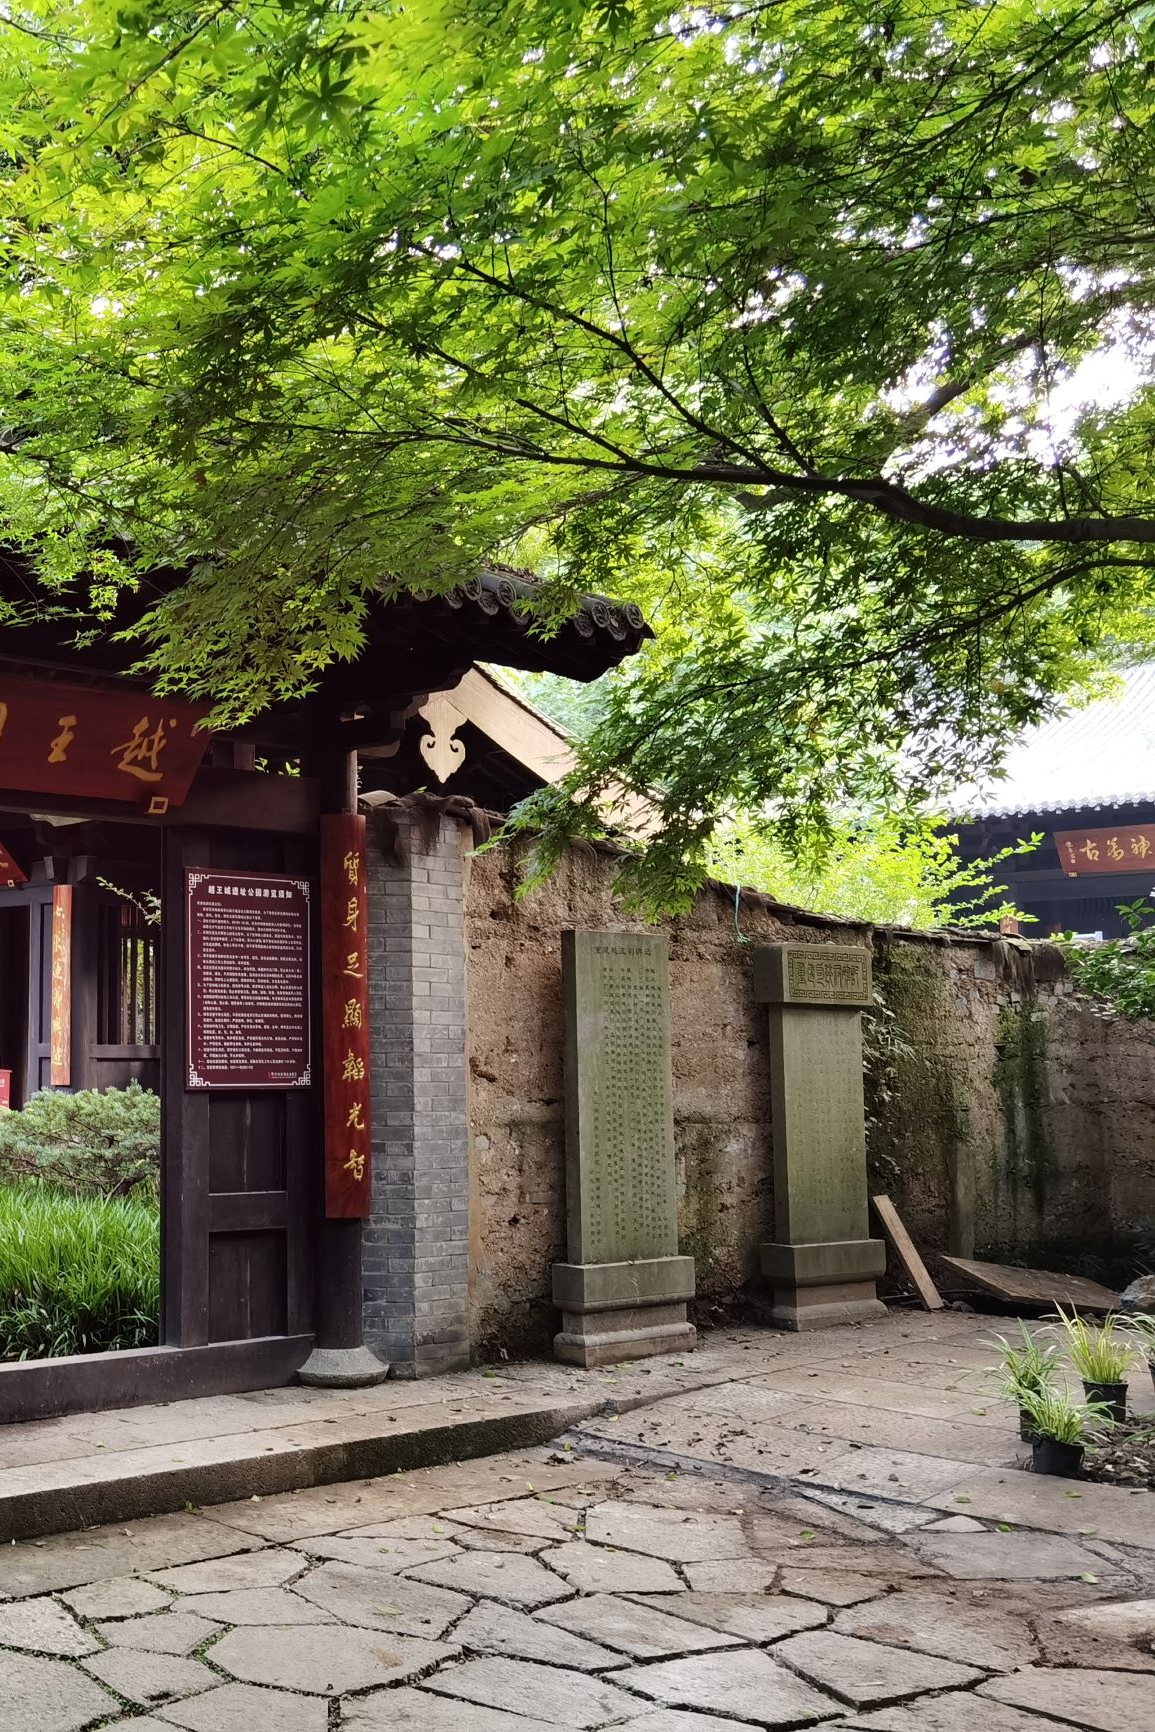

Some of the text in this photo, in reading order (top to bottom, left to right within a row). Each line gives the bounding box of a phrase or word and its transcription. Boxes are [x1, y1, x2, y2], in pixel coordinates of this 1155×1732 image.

[208, 885, 293, 899] 越王城遗址公园游览须知
